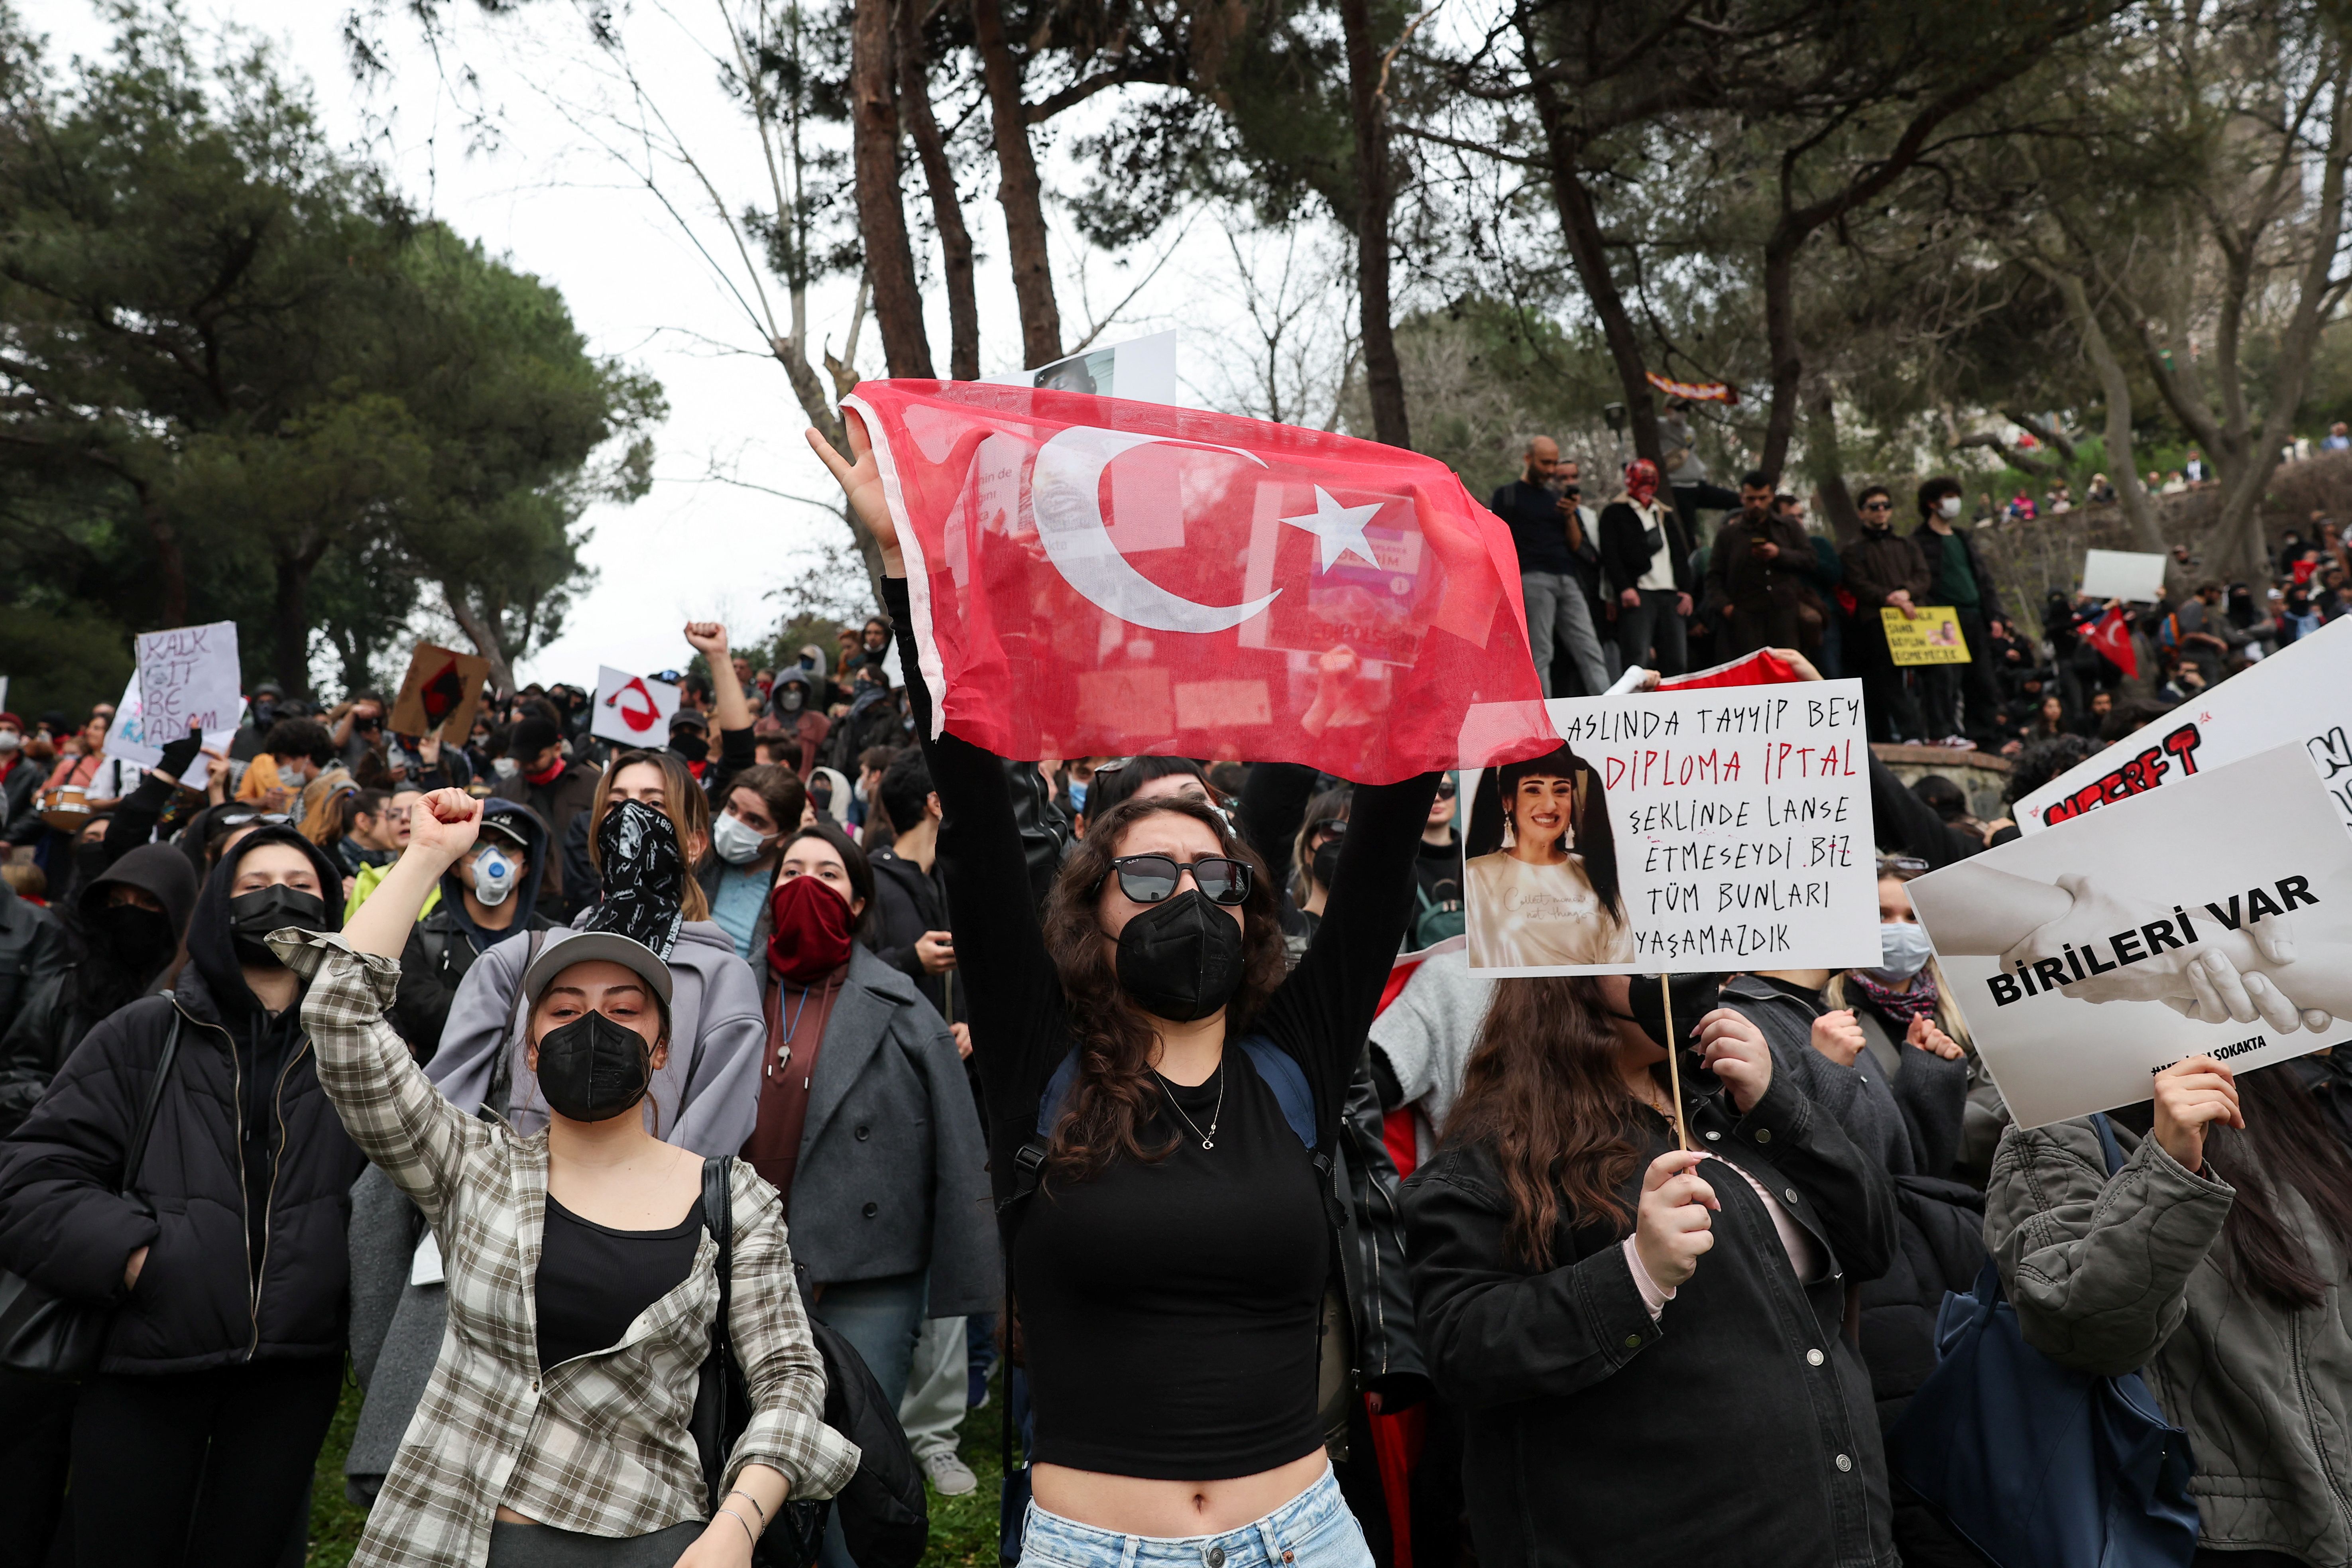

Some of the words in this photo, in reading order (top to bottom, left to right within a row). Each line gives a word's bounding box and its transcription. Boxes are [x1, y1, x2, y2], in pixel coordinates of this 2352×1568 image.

[146, 629, 211, 661] KALK
[147, 687, 182, 717] BE
[1567, 710, 1679, 742] ASLINDA
[1697, 699, 1789, 734] TAYYİP
[1808, 697, 1859, 728] BEY
[1606, 749, 1741, 791] DİPLOMA
[1765, 740, 1856, 784] İPTAL
[655, 815, 674, 835] 1881
[1630, 799, 1750, 834] ŞEKLİNDE
[1768, 795, 1849, 826] LANSE
[1645, 837, 1792, 873] ETMESEYDİ
[1811, 835, 1852, 867] BİZ
[1647, 882, 1699, 915] TÜM
[1718, 880, 1829, 913] BUNLARI
[1635, 924, 1790, 958] YAŞAMAZDIK
[1986, 905, 2199, 1007] BİRİLERİ
[2204, 875, 2320, 931] VAR
